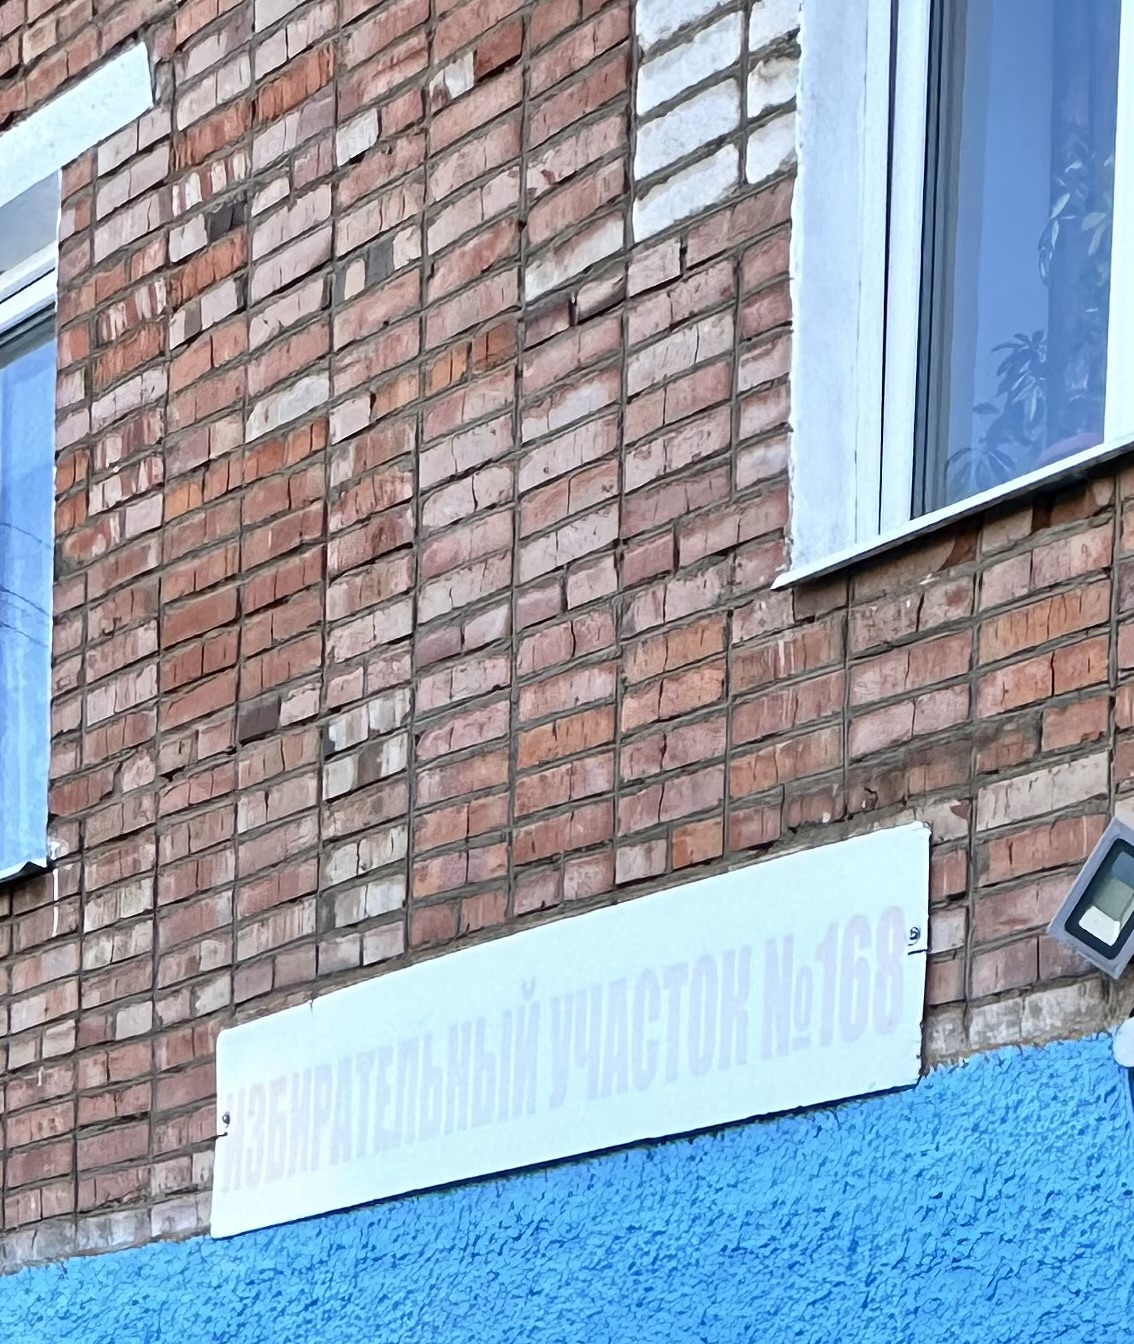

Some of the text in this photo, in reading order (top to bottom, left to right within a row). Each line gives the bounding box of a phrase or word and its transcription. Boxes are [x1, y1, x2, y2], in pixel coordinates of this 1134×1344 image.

[220, 905, 906, 1194] ИЗБИРАТЕЛЬНЫЙ УЧАСТОК №168
